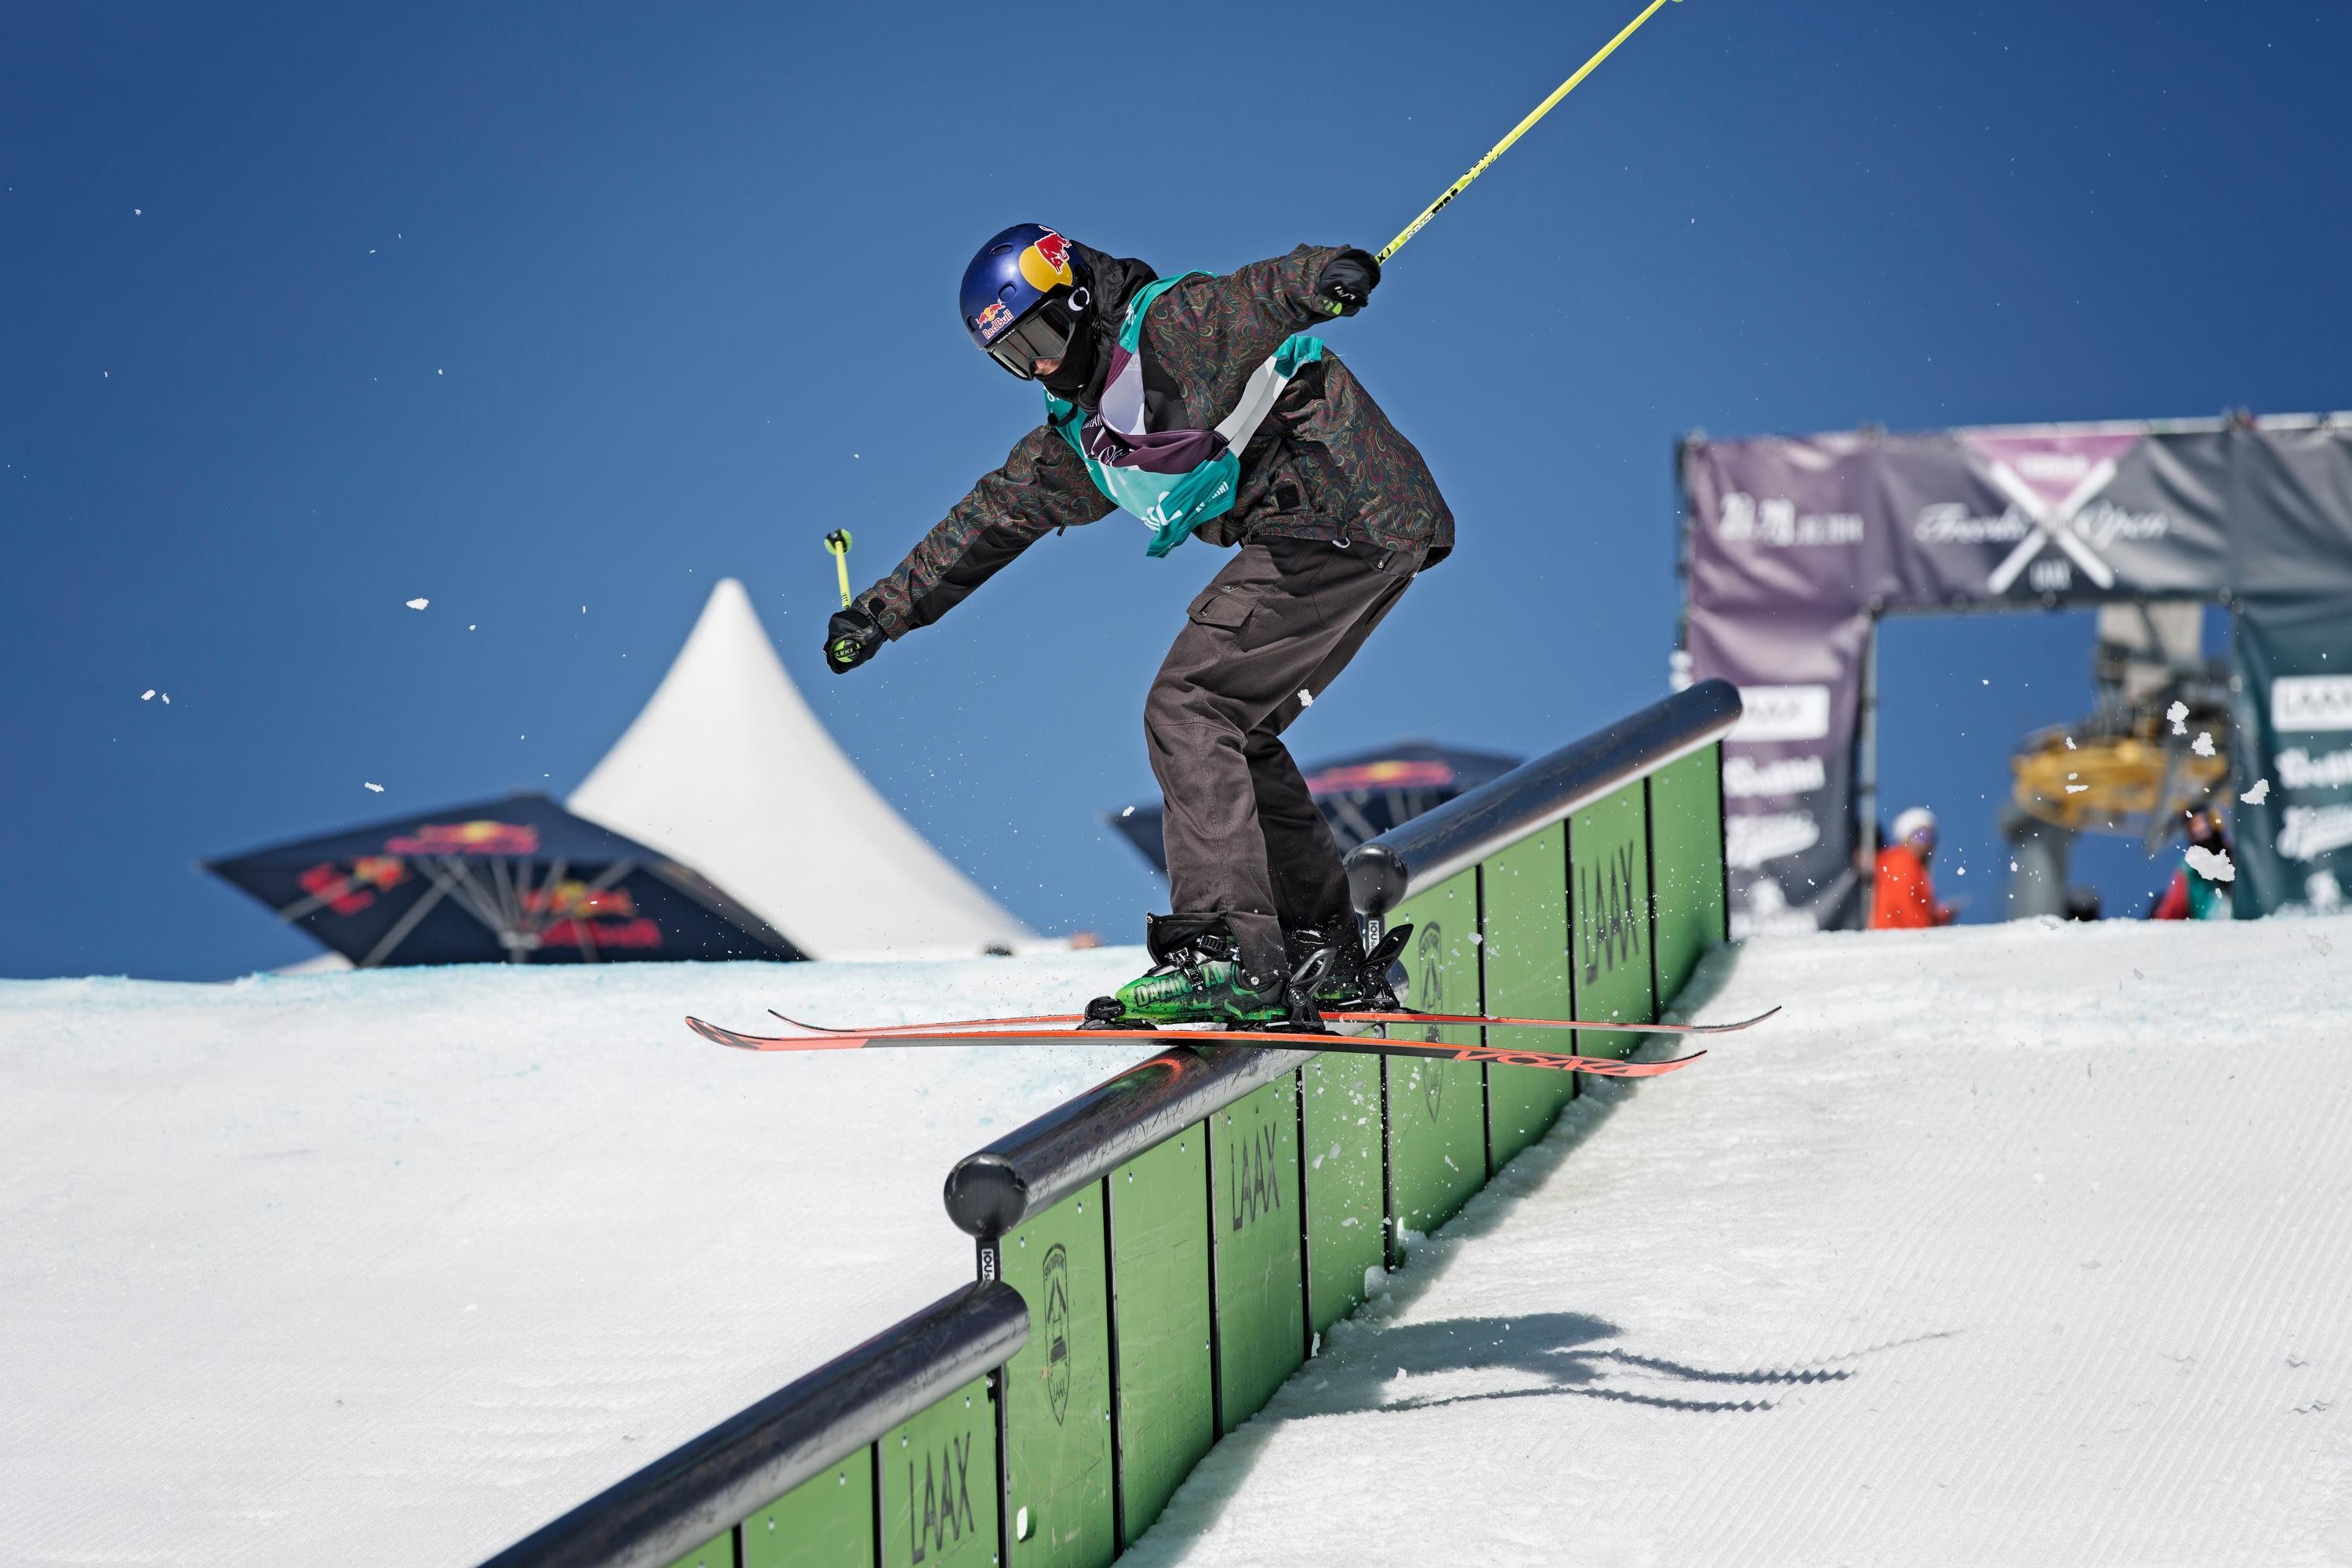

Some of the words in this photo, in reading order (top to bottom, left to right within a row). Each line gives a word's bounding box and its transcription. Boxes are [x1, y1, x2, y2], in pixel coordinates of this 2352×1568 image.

[835, 648, 853, 657] LEKI
[1581, 840, 1640, 986] LAAX
[1231, 1121, 1280, 1232] LAAX
[909, 1431, 975, 1565] LAAX
